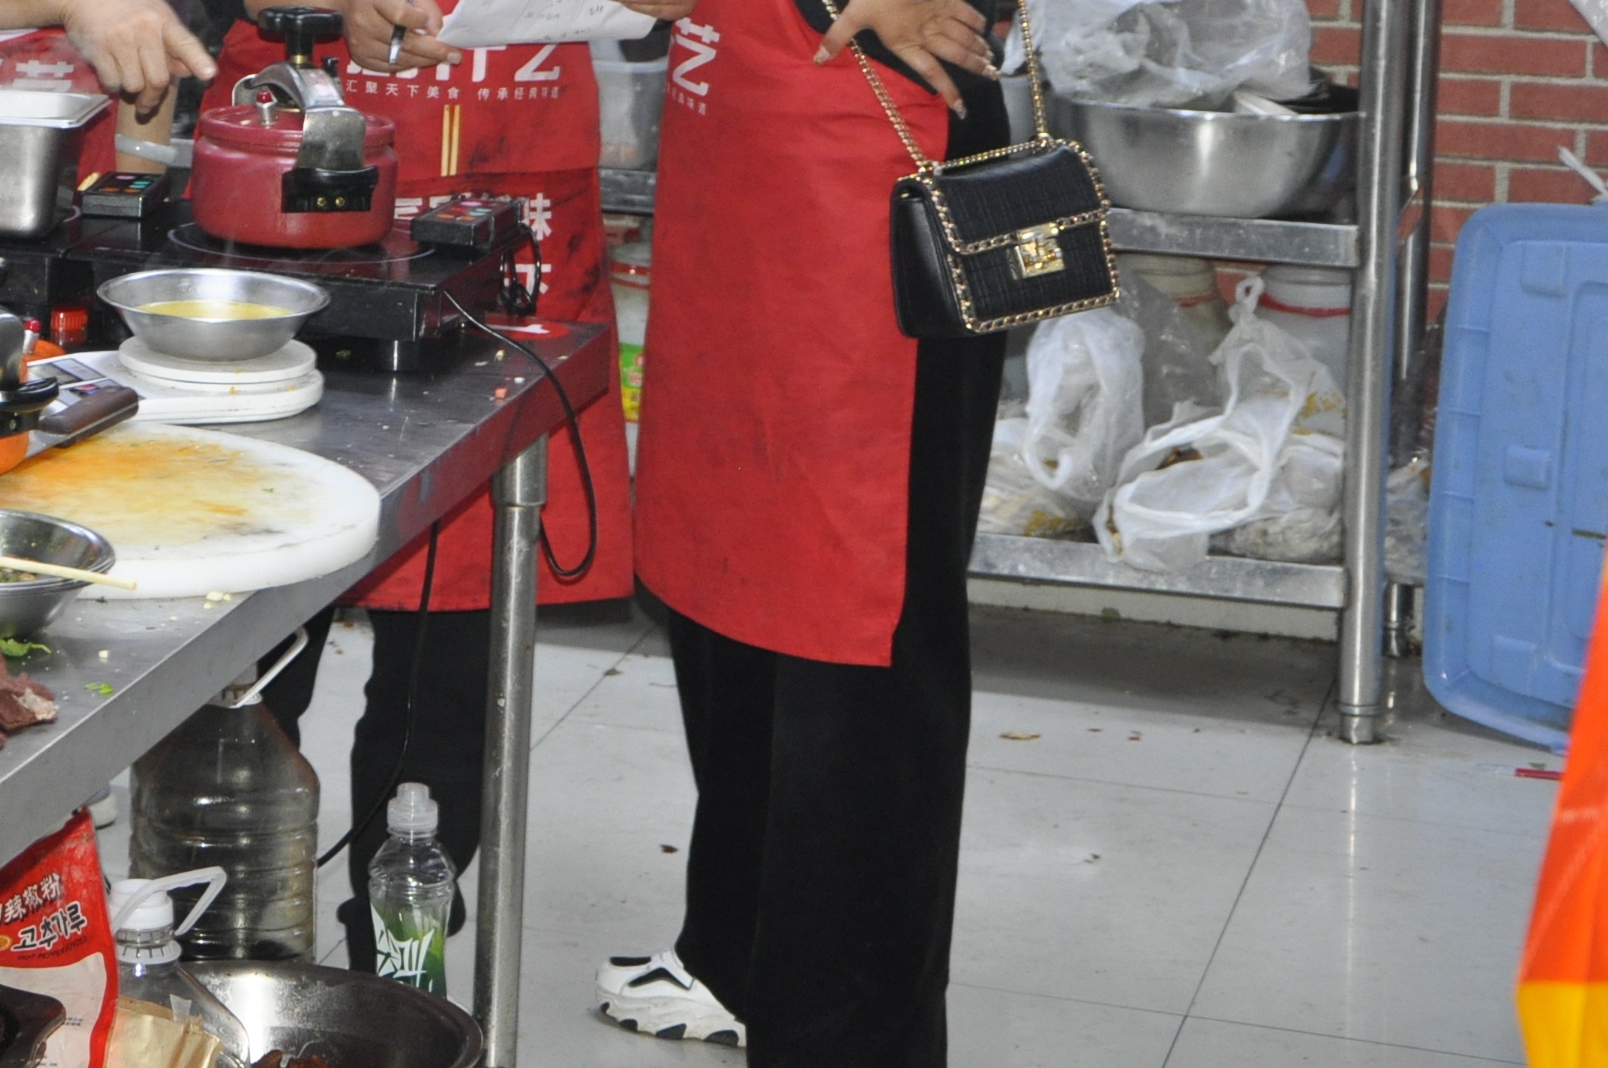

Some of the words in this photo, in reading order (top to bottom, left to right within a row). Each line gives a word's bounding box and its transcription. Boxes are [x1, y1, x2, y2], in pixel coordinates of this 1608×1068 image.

[673, 17, 720, 97] 艺
[346, 80, 460, 100] 汇聚天下美食
[477, 86, 561, 102] 传承经典味道
[11, 901, 88, 951] 고추가루
